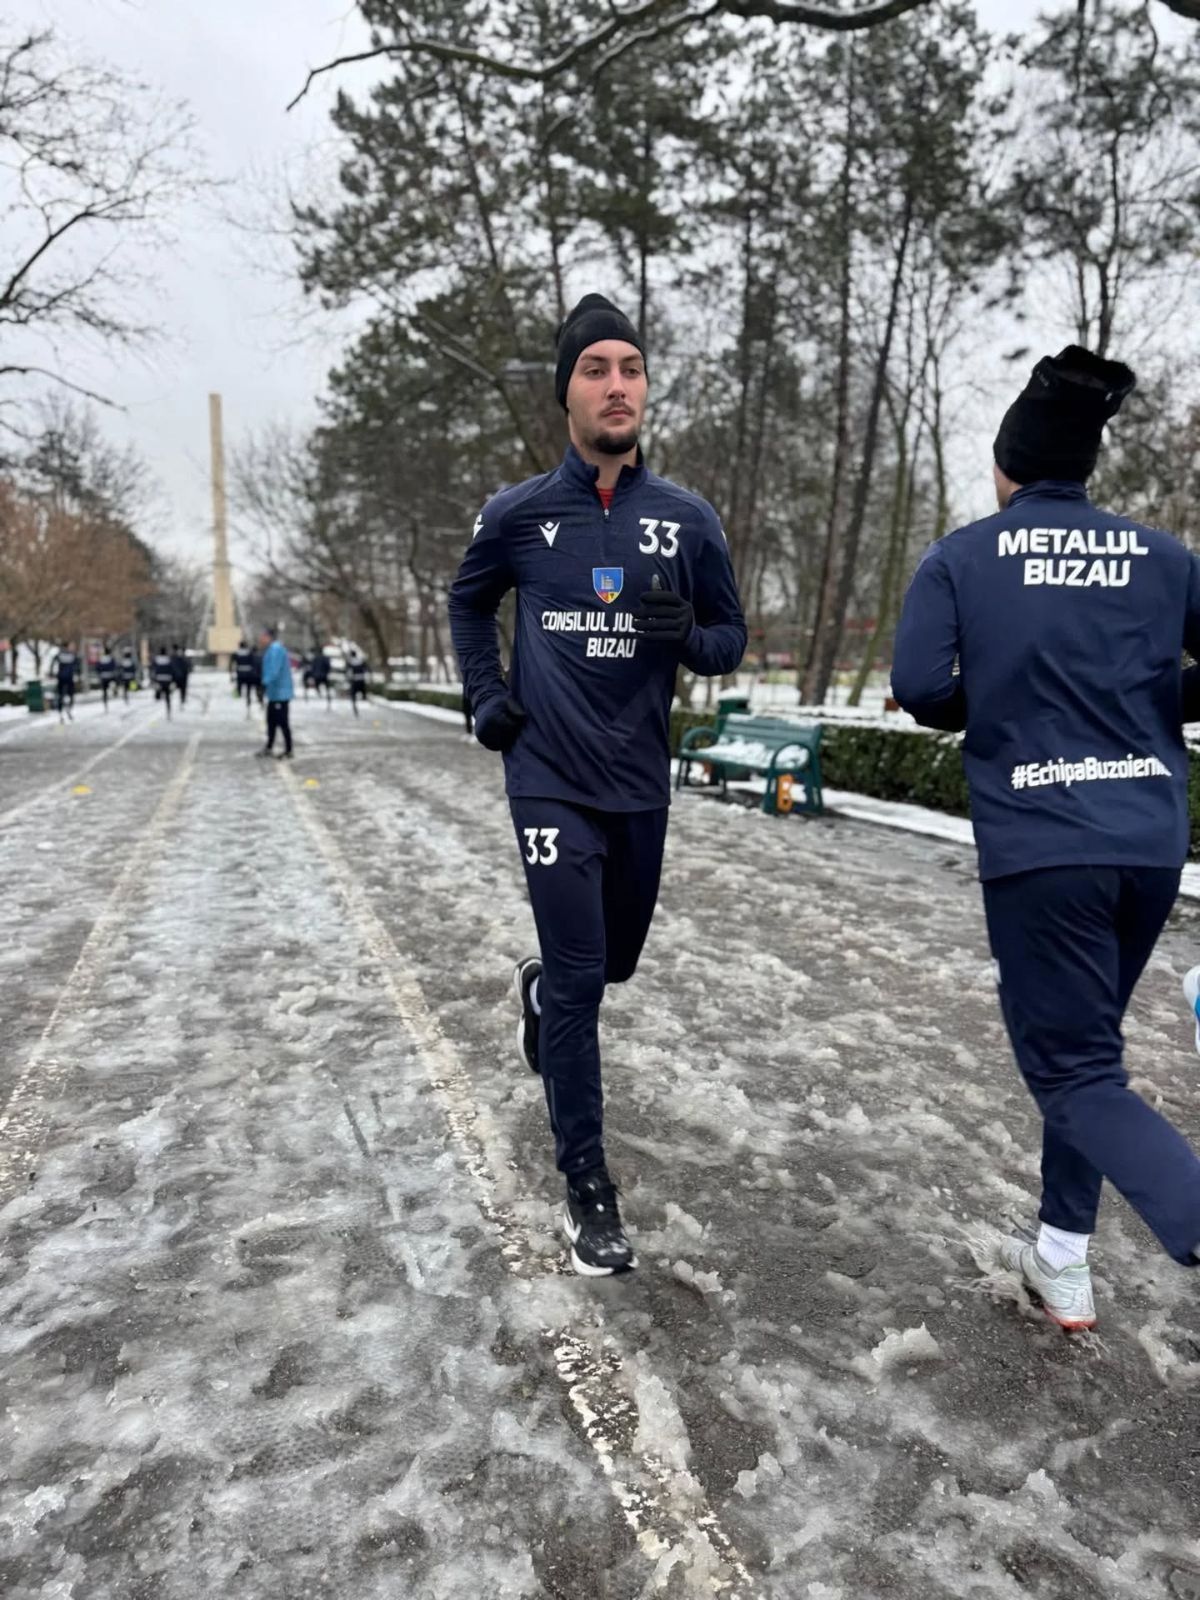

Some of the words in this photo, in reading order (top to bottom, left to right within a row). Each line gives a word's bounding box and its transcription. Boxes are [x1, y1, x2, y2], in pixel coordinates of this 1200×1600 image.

[638, 517, 681, 558] 33
[998, 527, 1149, 556] METALUL
[1023, 558, 1131, 587] BUZAU
[541, 611, 609, 632] CONSILIUL
[585, 637, 637, 658] BUZAU
[523, 827, 560, 866] 33
